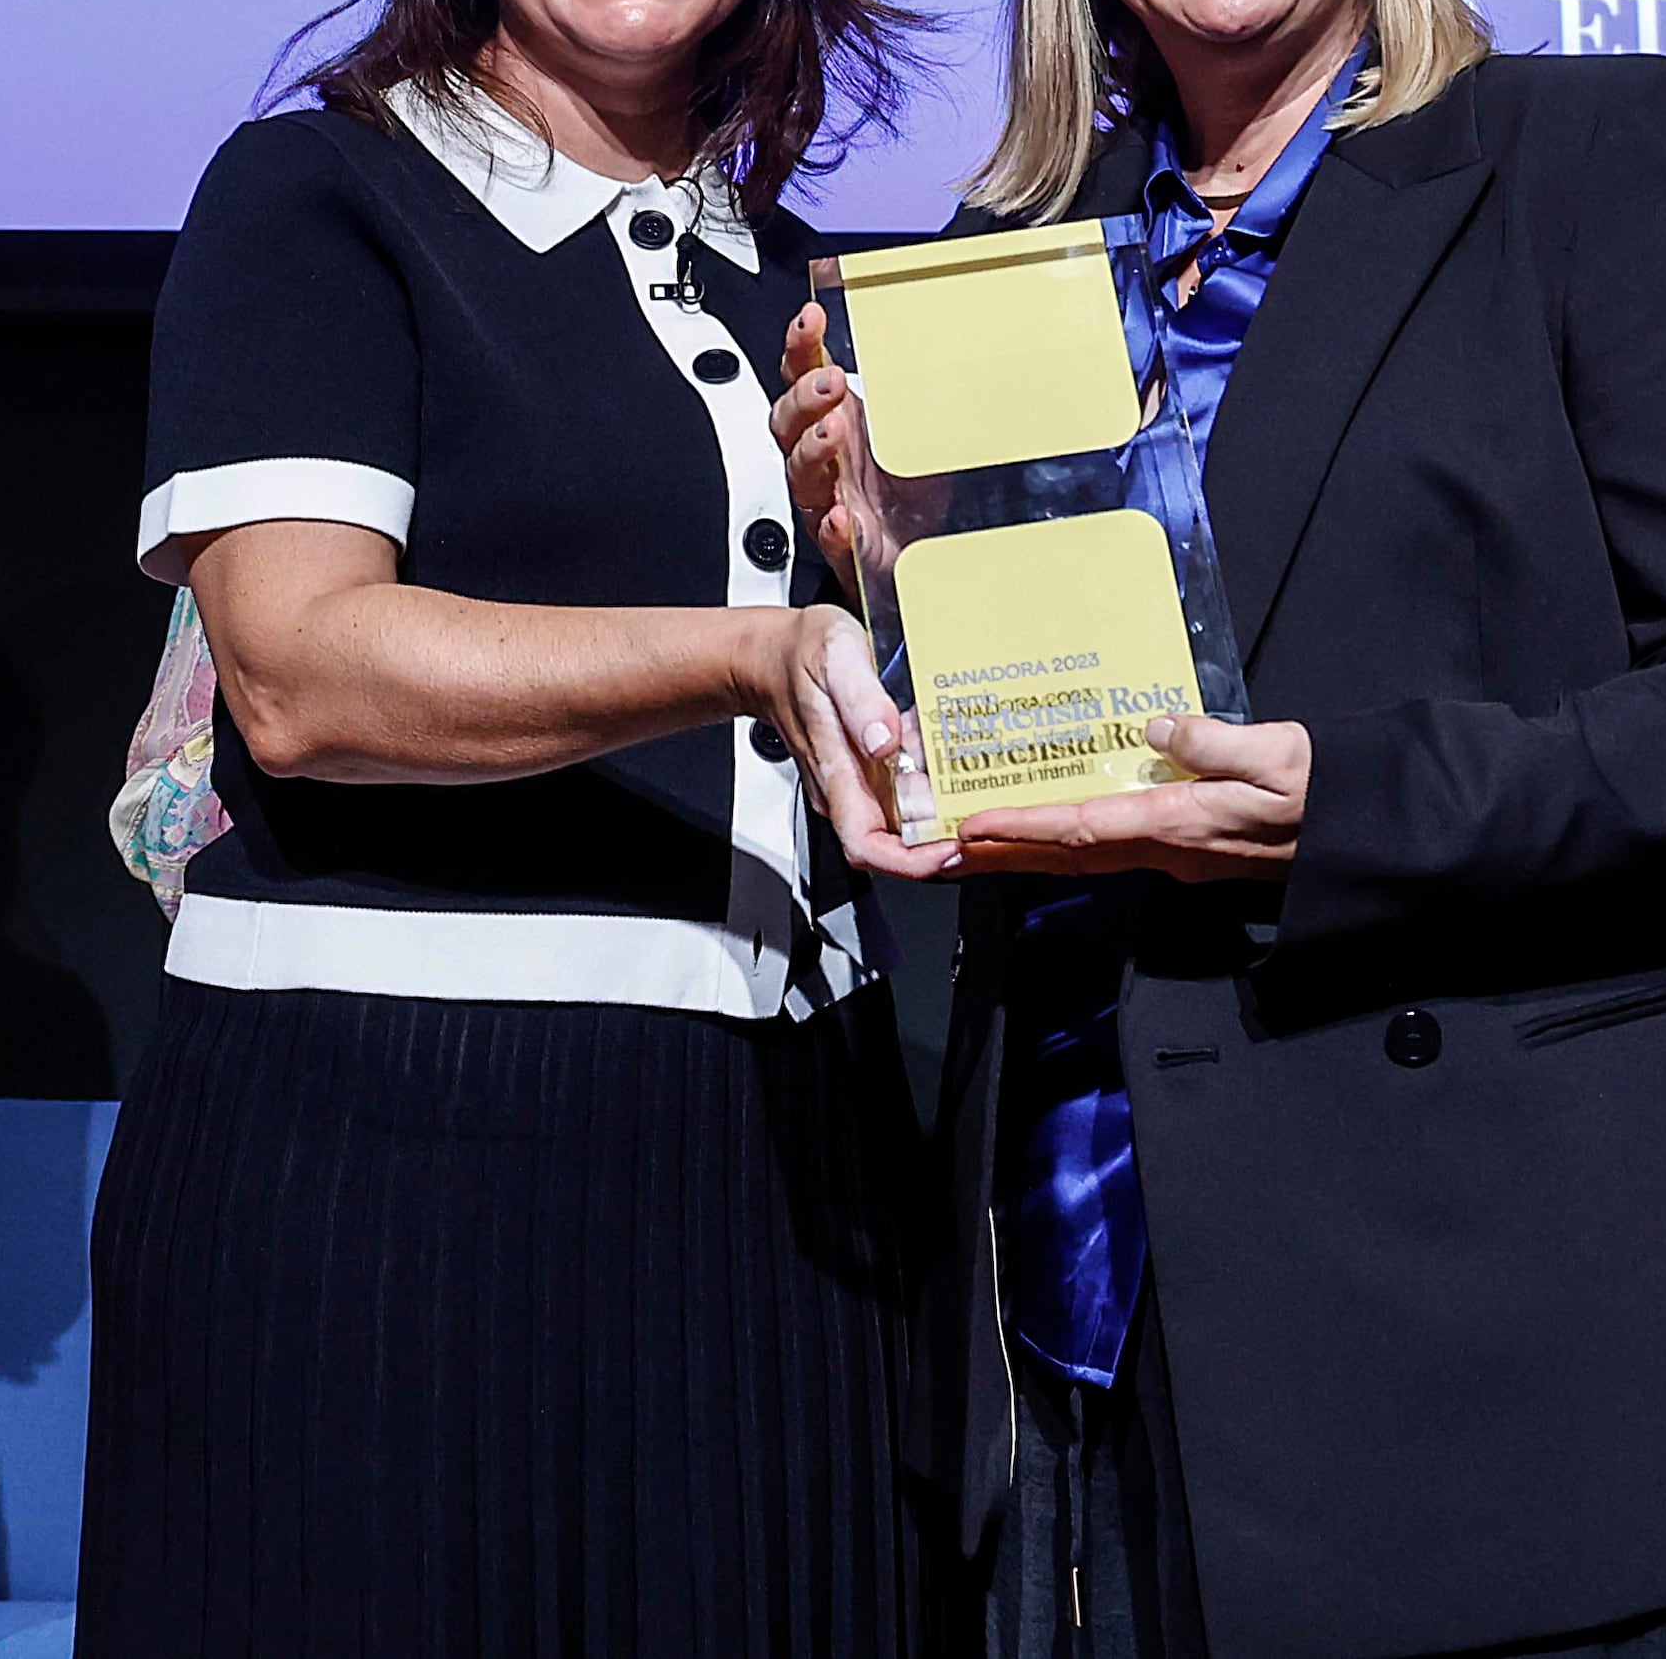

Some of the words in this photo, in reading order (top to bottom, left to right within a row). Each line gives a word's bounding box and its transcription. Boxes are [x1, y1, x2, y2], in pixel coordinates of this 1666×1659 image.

[933, 660, 1049, 690] GANADORA
[1053, 651, 1101, 674] 2023
[1108, 682, 1191, 717] Roig
